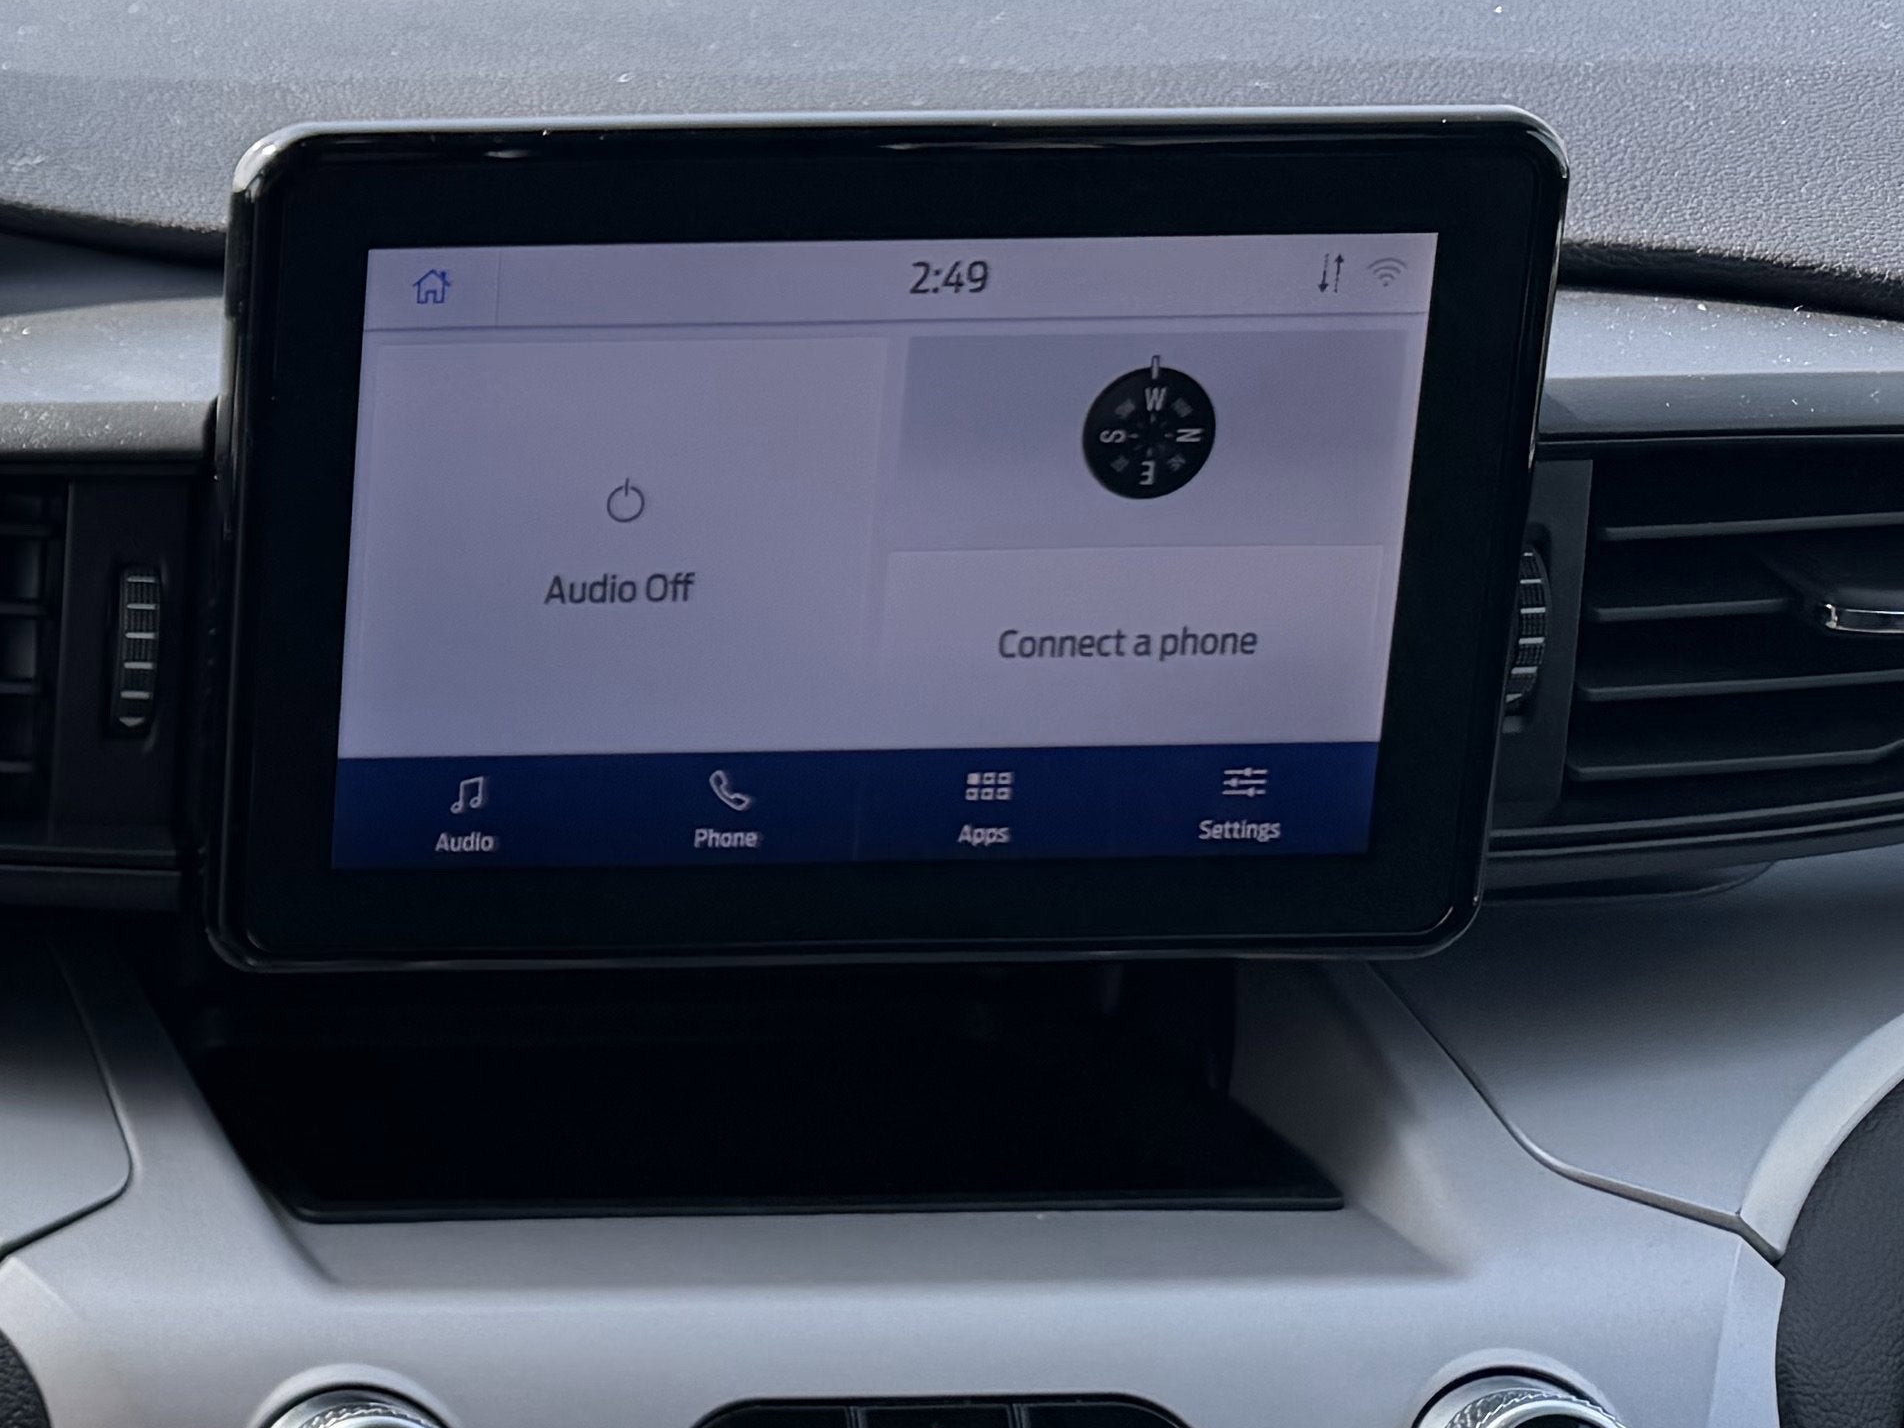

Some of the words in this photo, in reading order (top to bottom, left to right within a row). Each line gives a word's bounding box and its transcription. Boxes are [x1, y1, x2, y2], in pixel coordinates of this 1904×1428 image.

[909, 260, 990, 295] 2:49
[1145, 387, 1167, 412] W
[1099, 429, 1127, 443] S
[1139, 460, 1156, 486] E
[544, 574, 638, 605] Audio
[646, 572, 695, 603] Off
[998, 628, 1126, 659] Connect
[1134, 634, 1152, 658] a
[1159, 627, 1258, 663] phone
[435, 831, 494, 854] Audio
[694, 827, 759, 851] Phone
[958, 824, 1011, 847] Apps
[1198, 818, 1282, 844] Settings
